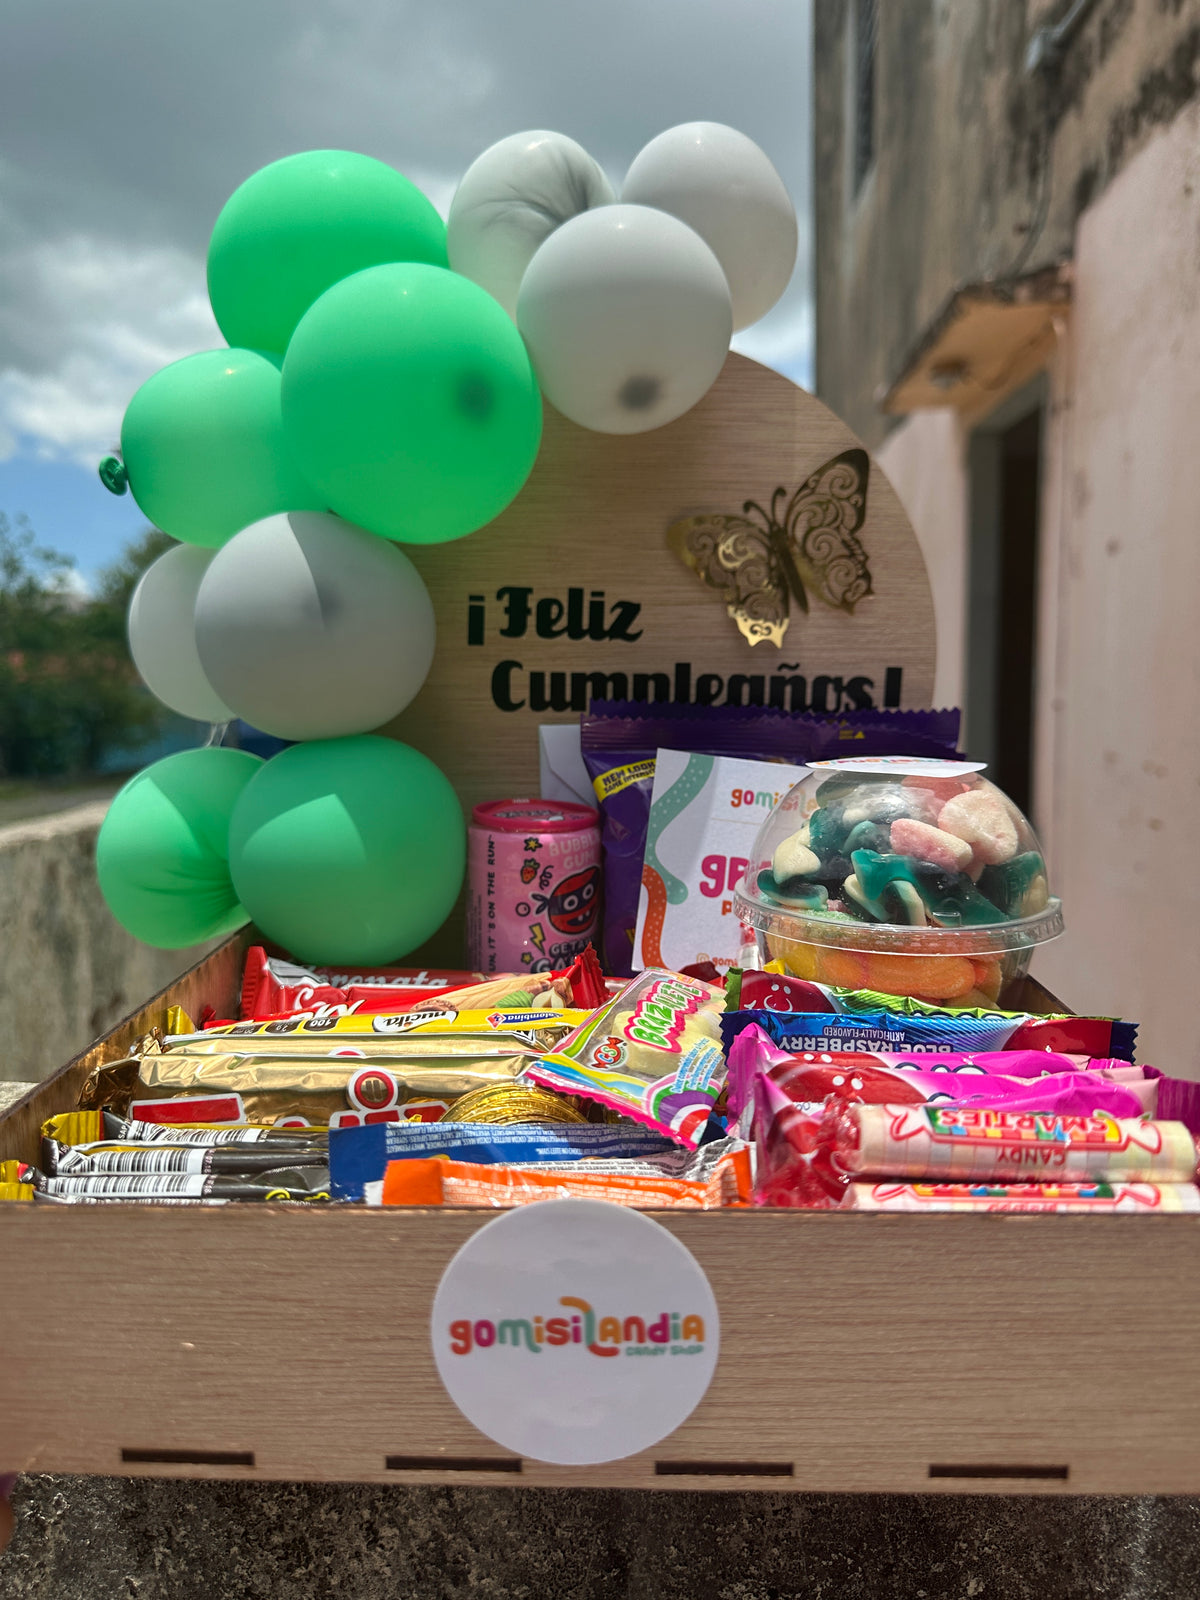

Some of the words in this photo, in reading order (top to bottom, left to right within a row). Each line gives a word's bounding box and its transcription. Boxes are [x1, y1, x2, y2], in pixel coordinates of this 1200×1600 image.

[468, 586, 643, 646] ¡Feliz
[602, 769, 625, 786] NEW
[628, 761, 656, 775] LOOK
[563, 850, 595, 870] GUM
[487, 872, 496, 896] THE
[487, 902, 496, 919] ON
[384, 1011, 447, 1027] nucita
[824, 1027, 860, 1037] FLAVORED
[861, 1029, 905, 1041] ARTIFICIALLY
[779, 1036, 893, 1053] RASPBERRY
[939, 1110, 1109, 1134] SMARTIES
[997, 1146, 1066, 1166] CANDY
